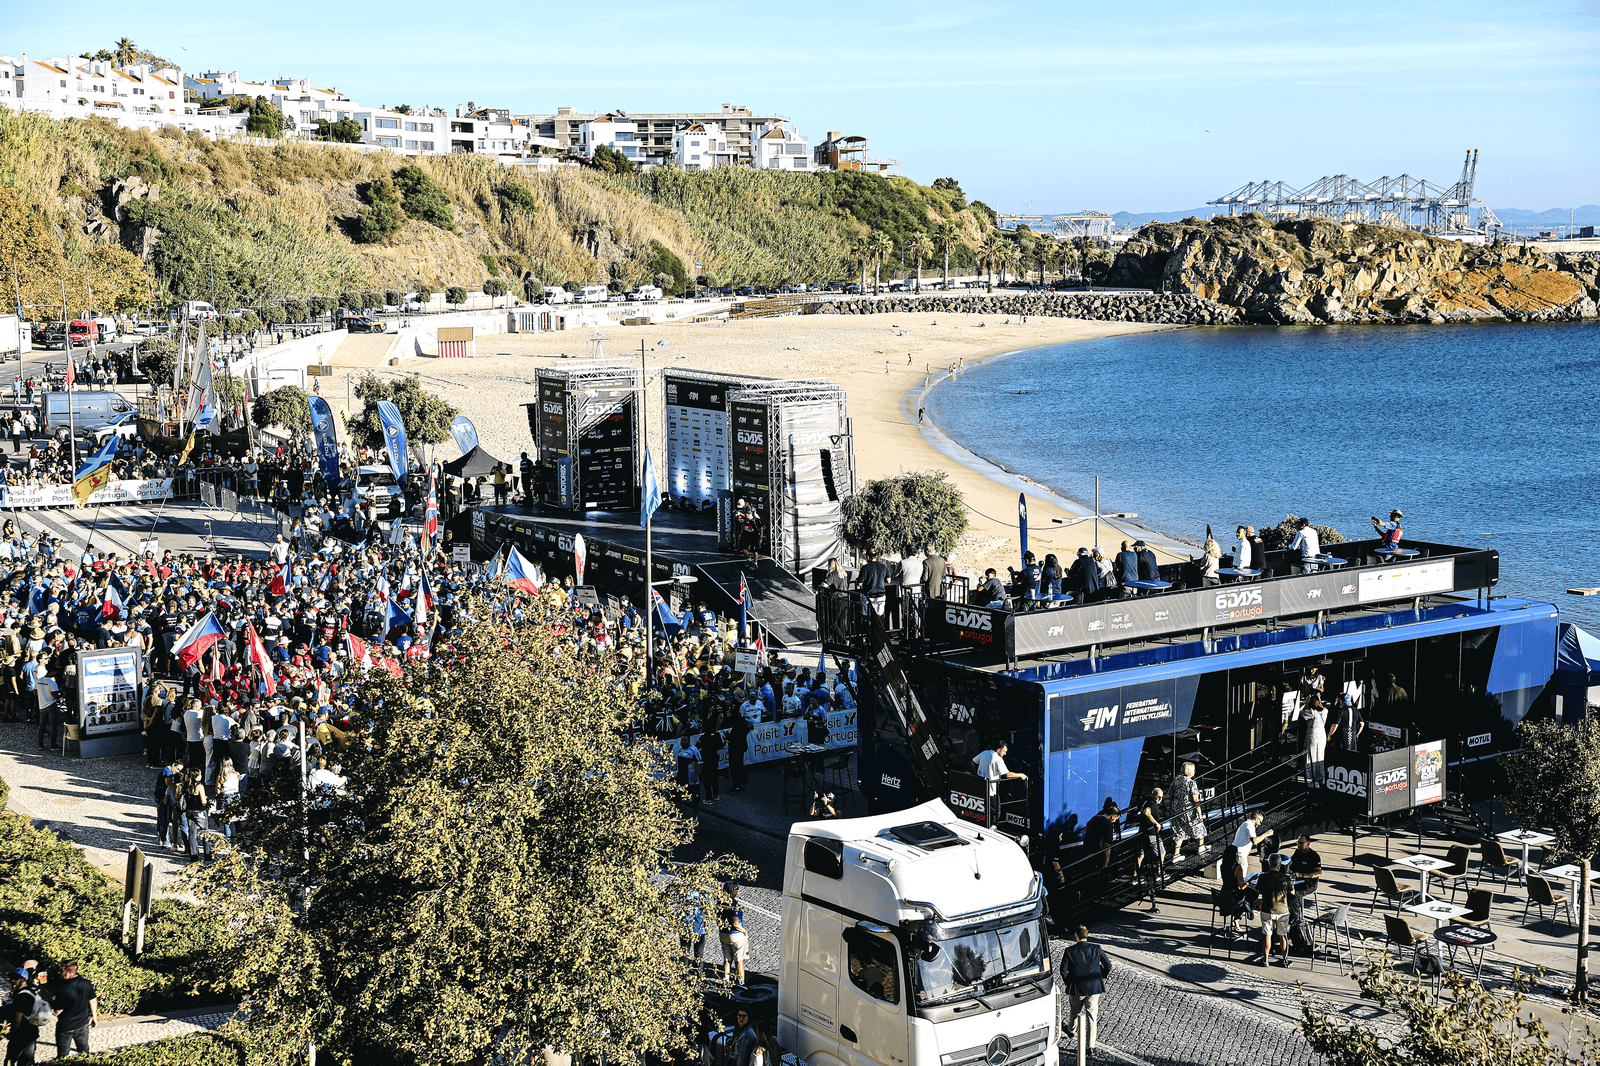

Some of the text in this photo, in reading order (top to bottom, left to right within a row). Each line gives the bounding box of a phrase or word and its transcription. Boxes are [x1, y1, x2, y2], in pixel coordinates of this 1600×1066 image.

[737, 431, 764, 446] 6DAYS
[53, 487, 69, 495] visit
[94, 491, 128, 500] Portugal
[9, 496, 43, 505] Portugal
[1215, 589, 1263, 610] 6DAYS
[1307, 588, 1322, 599] FIM
[945, 608, 993, 631] 6DAYS
[1229, 606, 1264, 621] portugal
[1047, 625, 1065, 637] FIM
[1111, 622, 1133, 630] Portugal
[959, 629, 993, 645] portugal
[1123, 703, 1169, 718] INTERNATIONALE
[1125, 698, 1158, 710] FEDERATION
[949, 702, 976, 724] FIM
[1080, 704, 1120, 732] FIM
[1130, 709, 1170, 723] MOTOCYCLISME
[756, 727, 780, 741] visit
[824, 729, 858, 744] ortuga
[1468, 734, 1490, 747] MOTUL
[881, 773, 901, 787] Hertz
[1327, 765, 1363, 786] 100
[1374, 768, 1408, 786] 6DAYS
[1326, 778, 1367, 798] 6DAYS
[1384, 781, 1408, 794] portugal
[950, 792, 986, 813] 6DAYS
[960, 809, 986, 822] portugal
